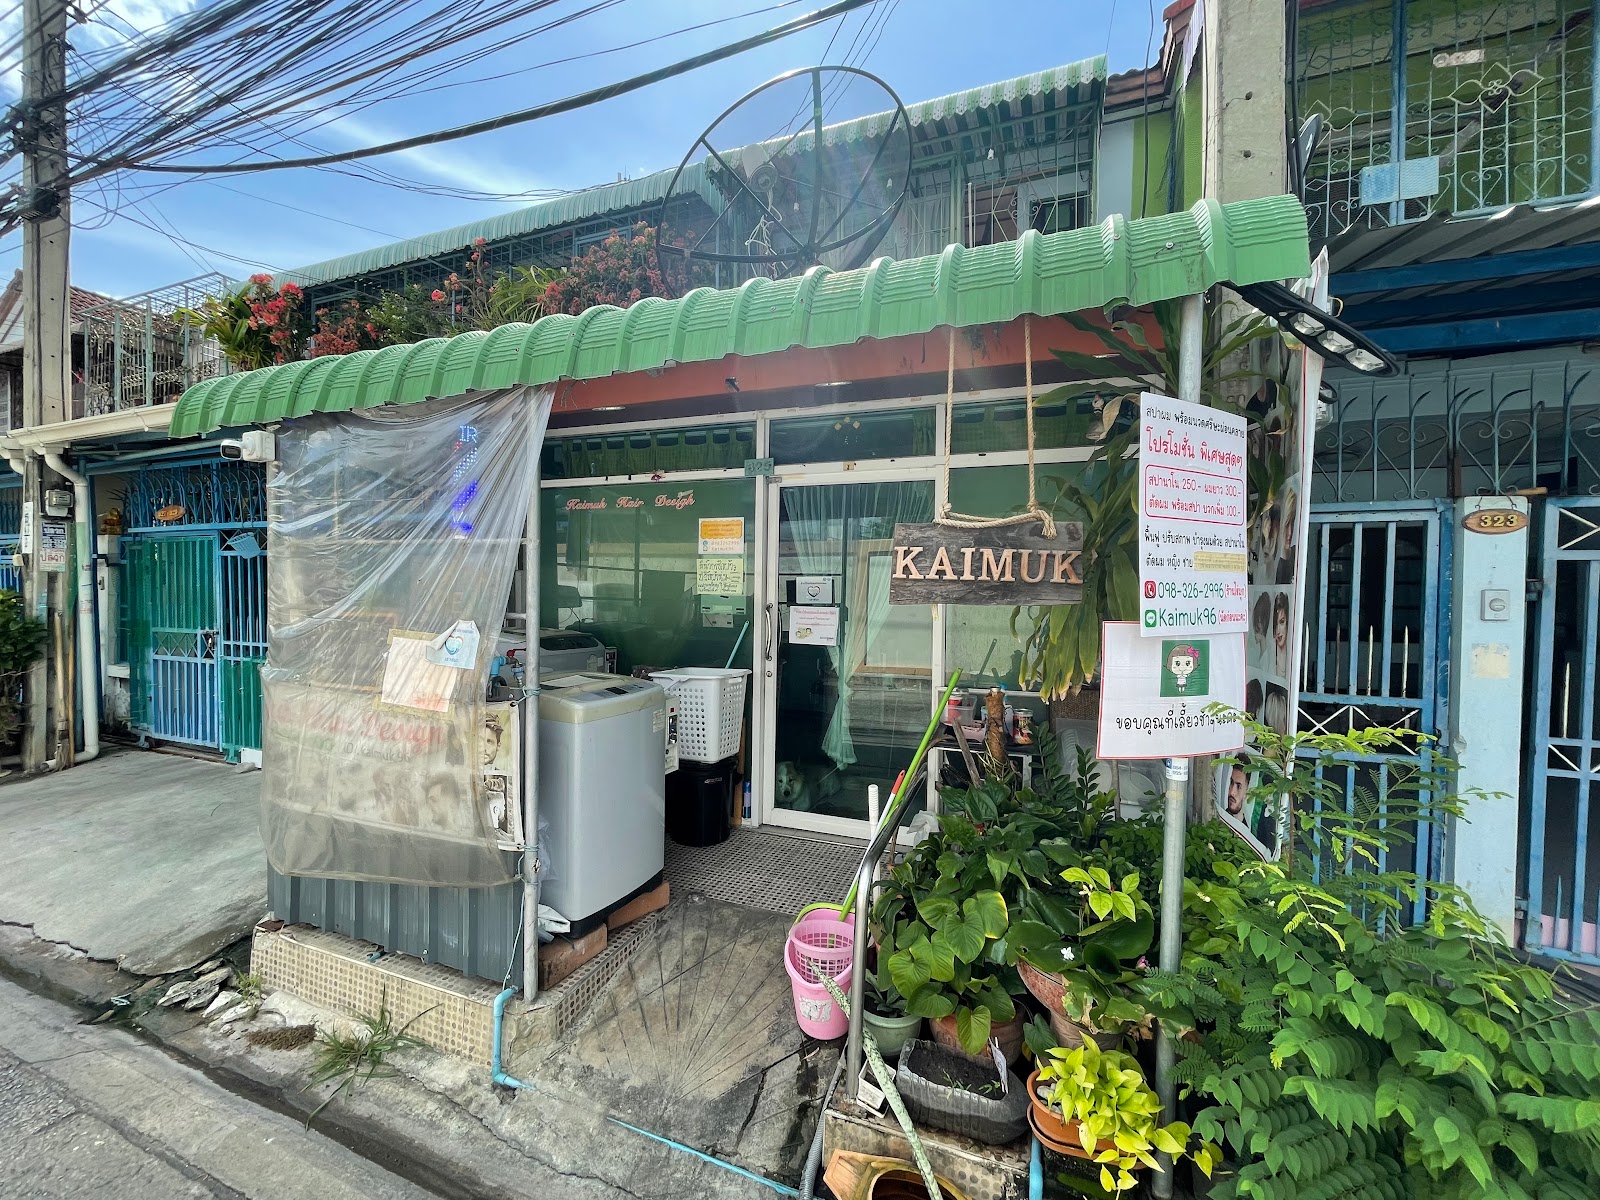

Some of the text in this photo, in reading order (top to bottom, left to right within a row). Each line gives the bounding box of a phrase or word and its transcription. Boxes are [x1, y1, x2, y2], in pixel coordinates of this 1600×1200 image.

[1146, 407, 1171, 421] สปาผม
[1146, 426, 1243, 473] โปรโมชั่น พิเศษสุดๆ
[1149, 472, 1179, 489] สปานาโน
[1182, 479, 1202, 491] 250.-
[565, 493, 695, 510] Kaimuk Hair Design
[1149, 494, 1168, 510] ตัดผม
[1172, 498, 1200, 513] พร้อมสปา
[1480, 514, 1518, 527] 323
[893, 546, 1083, 584] KAIMUK
[1146, 552, 1165, 567] ตัดผม
[1158, 582, 1224, 599] 098-326-2996
[1159, 607, 1217, 627] Kaimuk96
